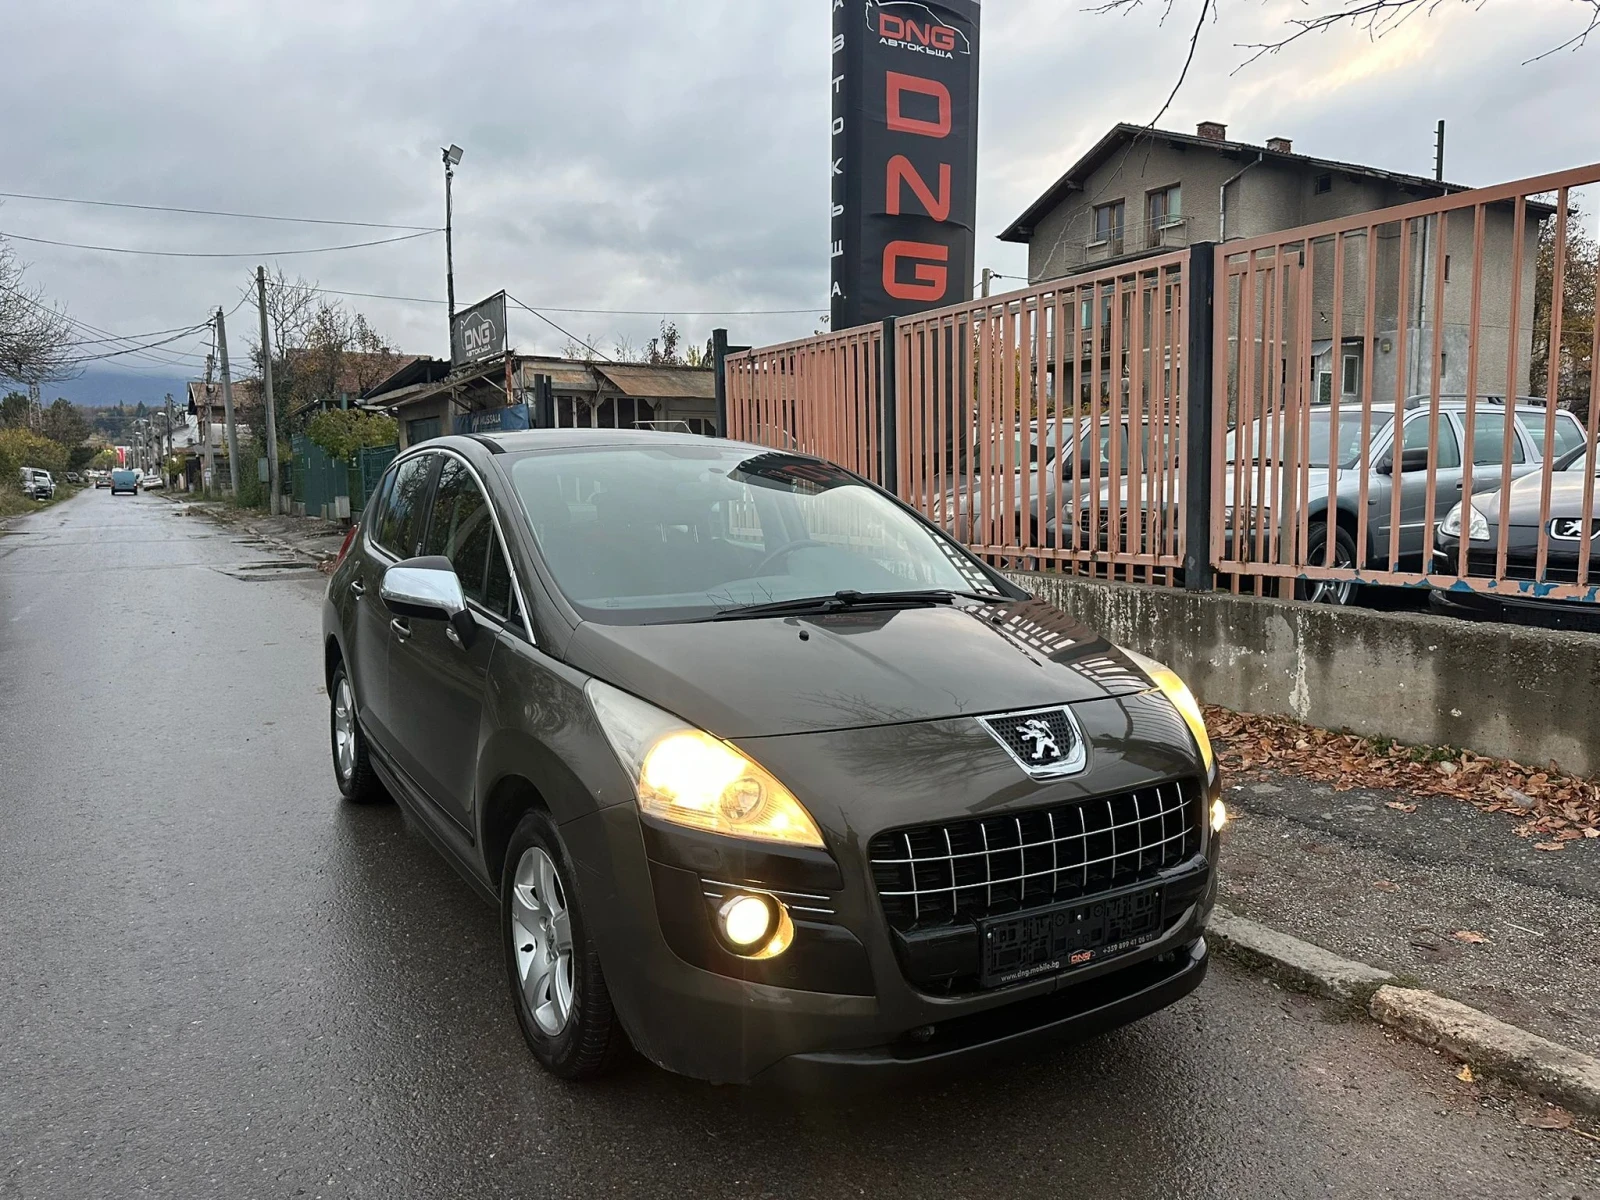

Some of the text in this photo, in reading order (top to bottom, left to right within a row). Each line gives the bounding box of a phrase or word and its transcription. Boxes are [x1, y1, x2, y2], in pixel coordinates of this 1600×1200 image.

[879, 12, 955, 51] DNG
[882, 70, 952, 302] DNG
[464, 322, 490, 350] DNG
